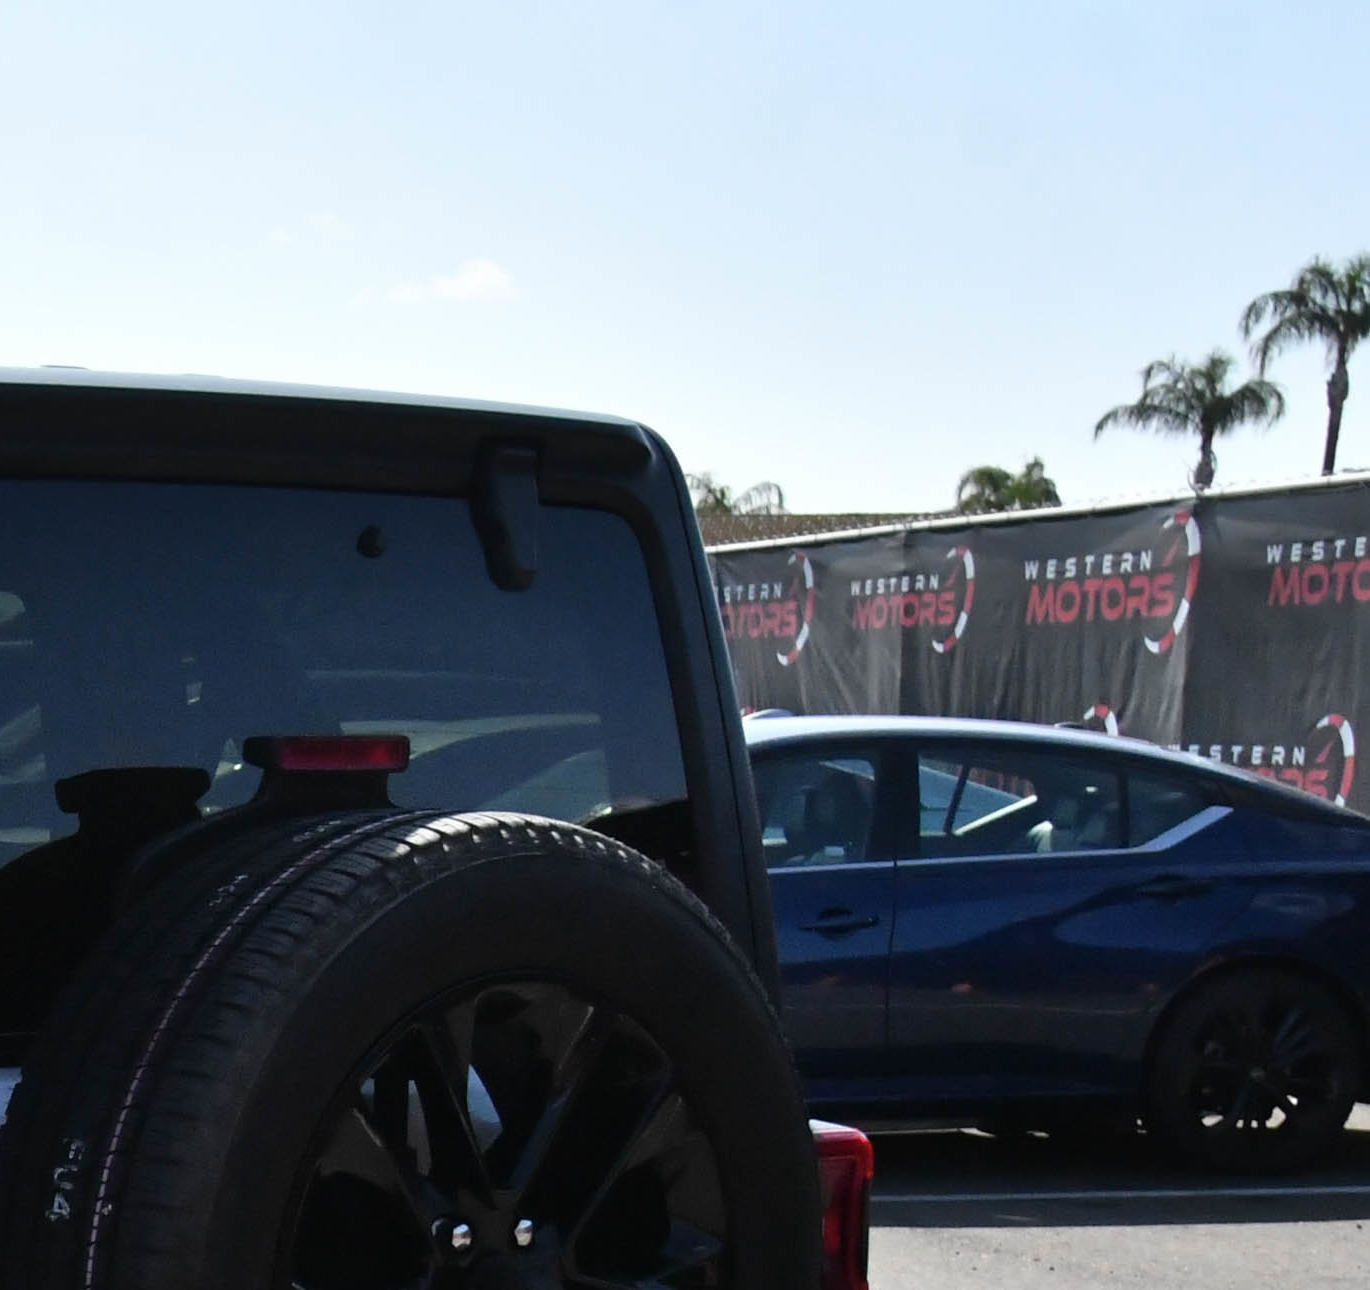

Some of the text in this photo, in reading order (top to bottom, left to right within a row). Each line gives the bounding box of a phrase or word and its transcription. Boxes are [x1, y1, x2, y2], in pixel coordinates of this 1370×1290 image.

[1024, 550, 1153, 580] WESTERN
[722, 582, 783, 603] STERN
[851, 574, 940, 596] WESTERN
[1026, 572, 1175, 625] MOTORS
[852, 591, 957, 630] MOTORS
